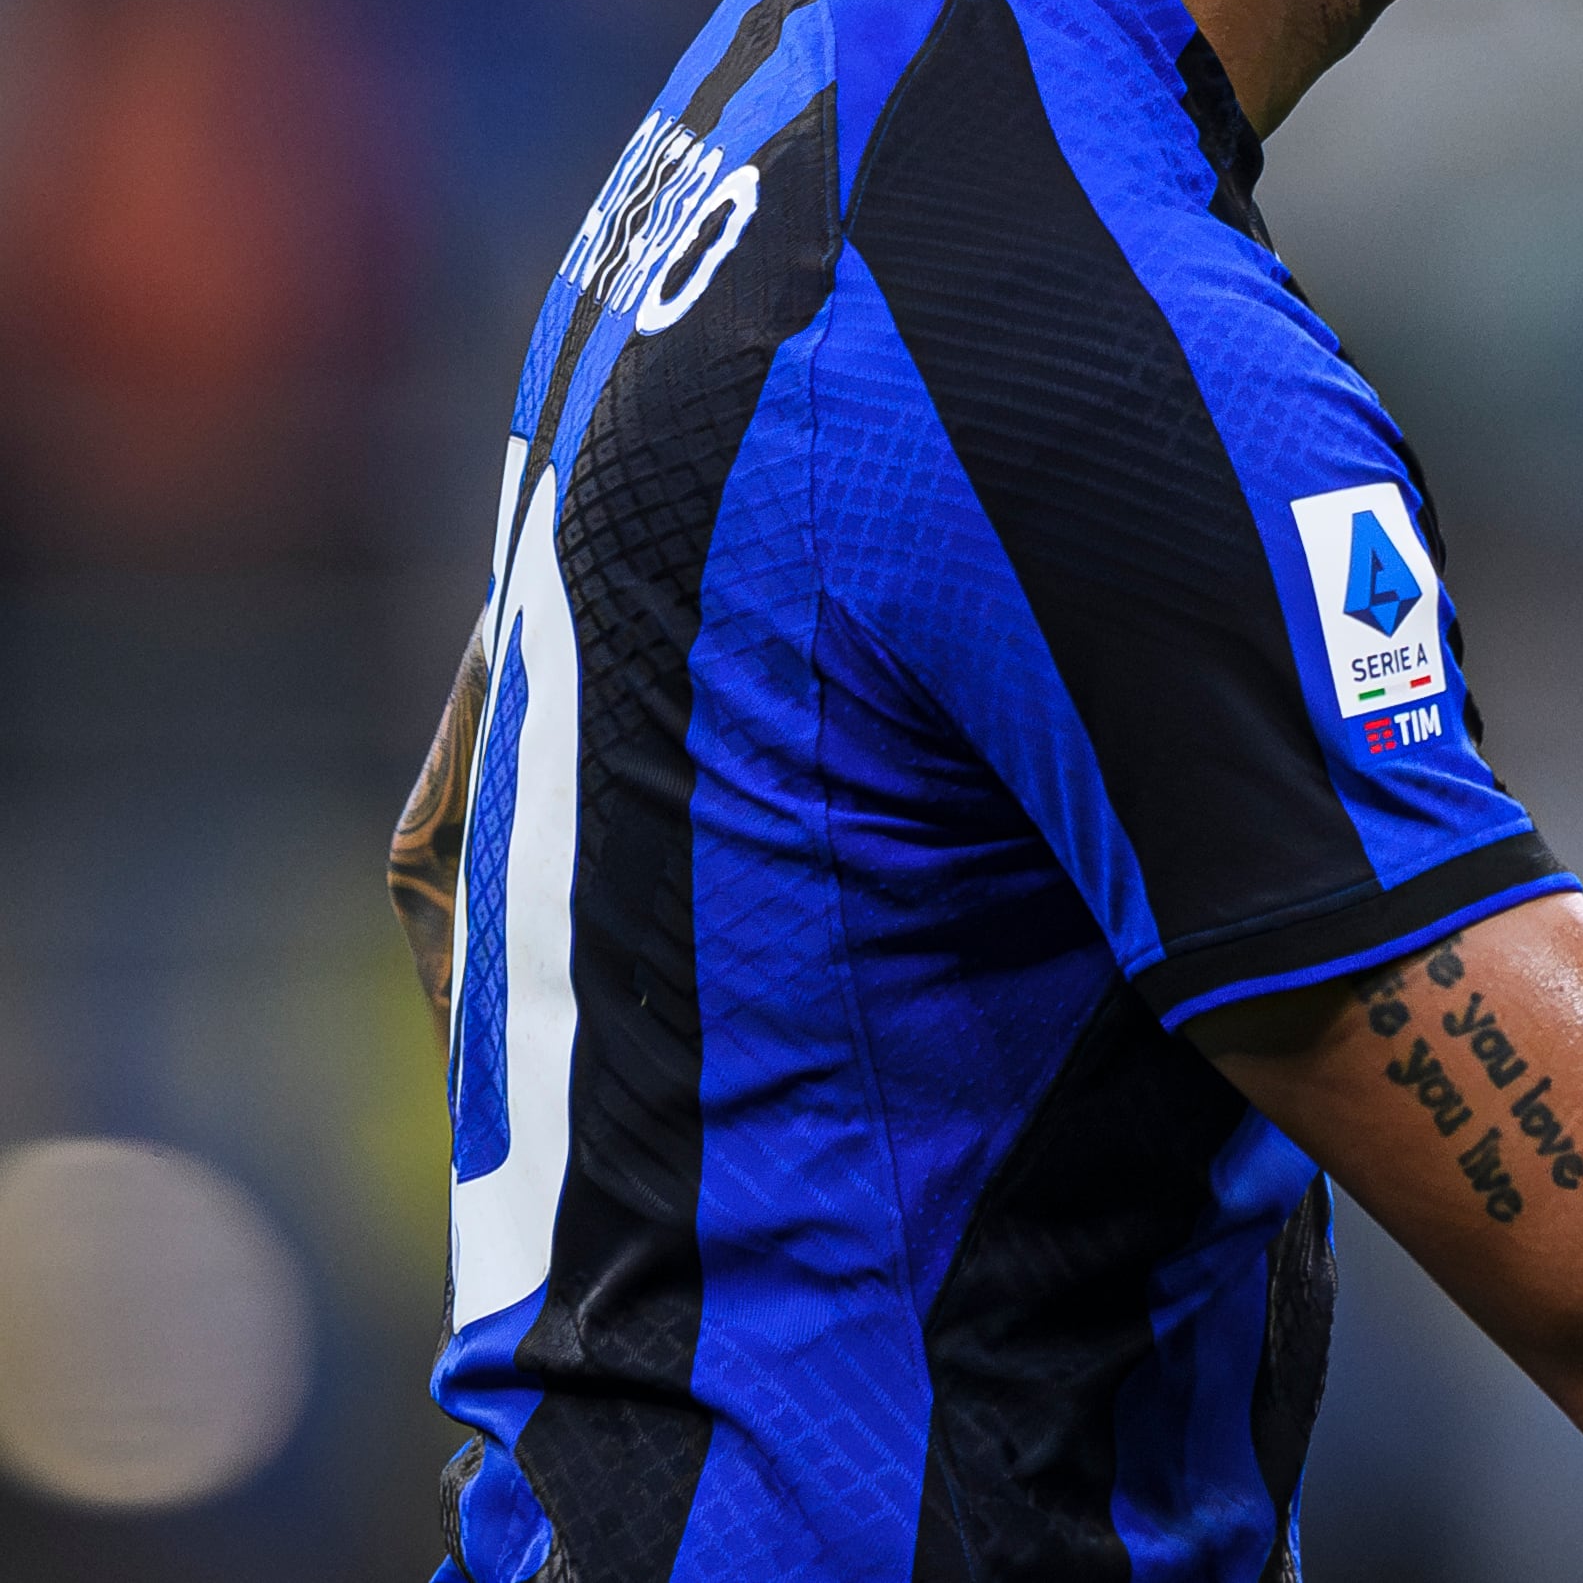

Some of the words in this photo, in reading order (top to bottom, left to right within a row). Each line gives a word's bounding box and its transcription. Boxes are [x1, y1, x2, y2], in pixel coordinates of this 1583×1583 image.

[1351, 646, 1412, 682] SERIE
[1416, 642, 1429, 667] A
[1393, 703, 1443, 746] TIM
[1442, 992, 1528, 1090] you
[1384, 1036, 1473, 1137] you
[1458, 1126, 1523, 1223] live
